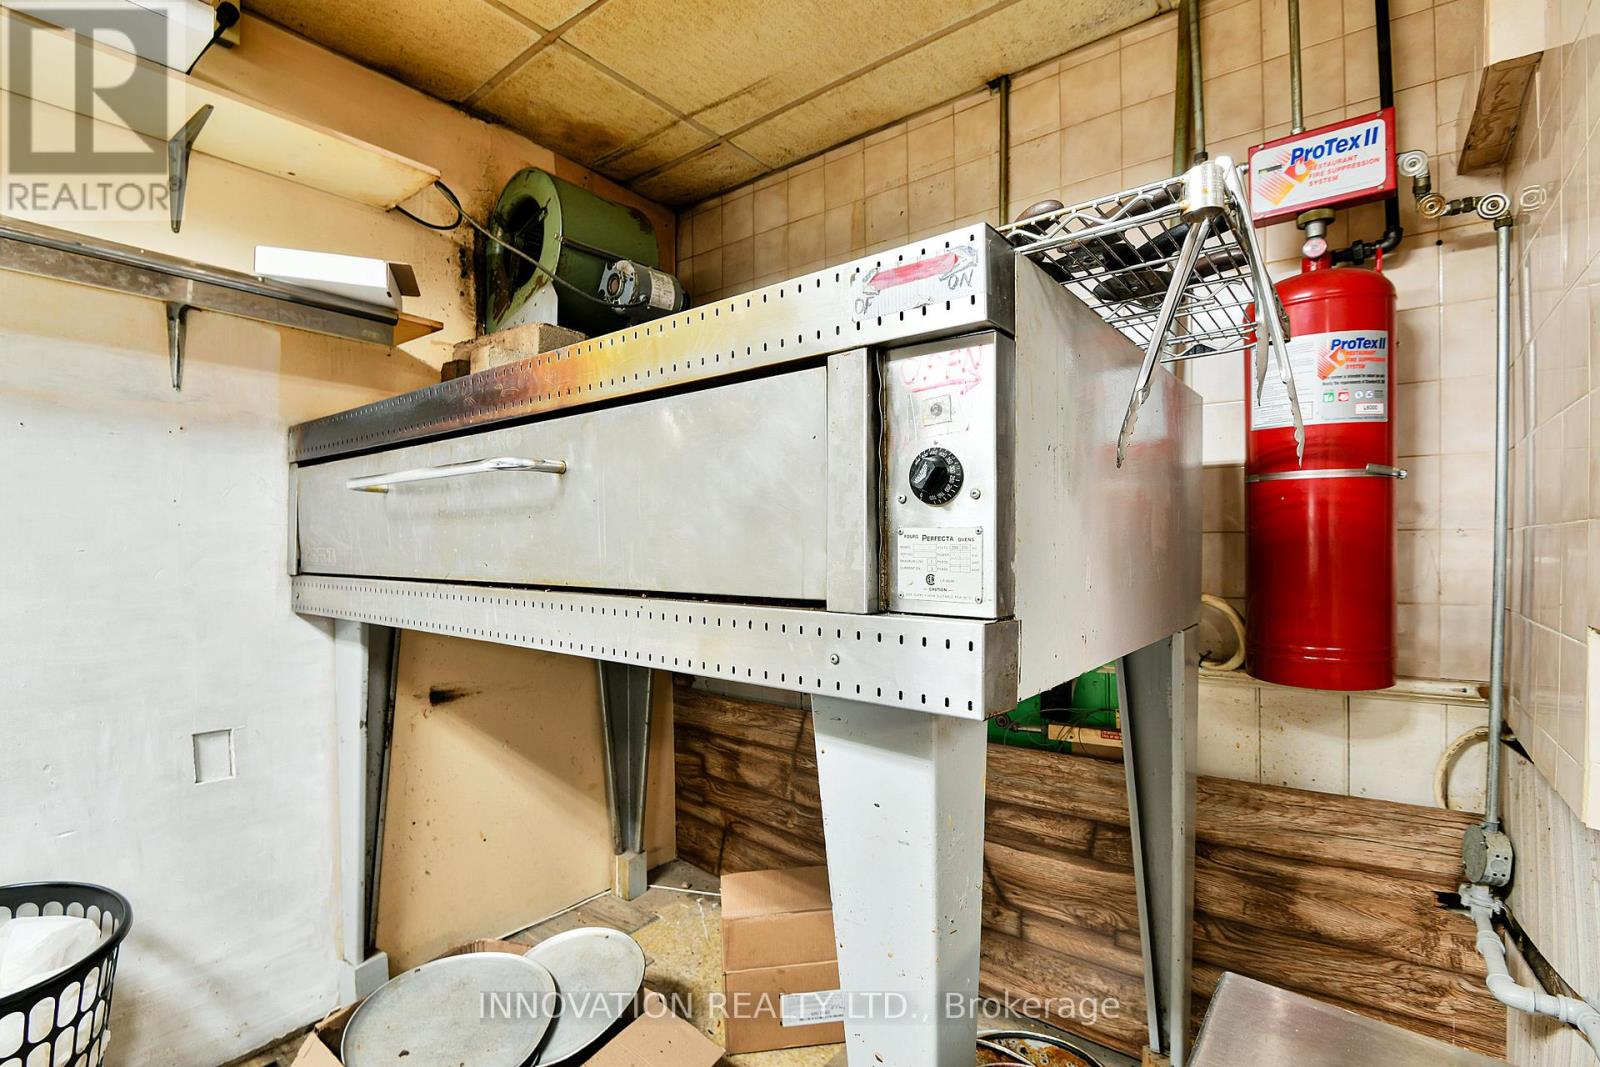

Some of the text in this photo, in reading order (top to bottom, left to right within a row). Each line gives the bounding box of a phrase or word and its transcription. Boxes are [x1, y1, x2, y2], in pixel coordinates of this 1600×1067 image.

[1290, 126, 1379, 165] ProTex II
[1327, 157, 1380, 174] SUPPRESSION
[1309, 175, 1339, 187] SYSTEM
[947, 269, 973, 290] ON
[1330, 337, 1379, 351] ProTex
[921, 534, 955, 542] PERFECTA
